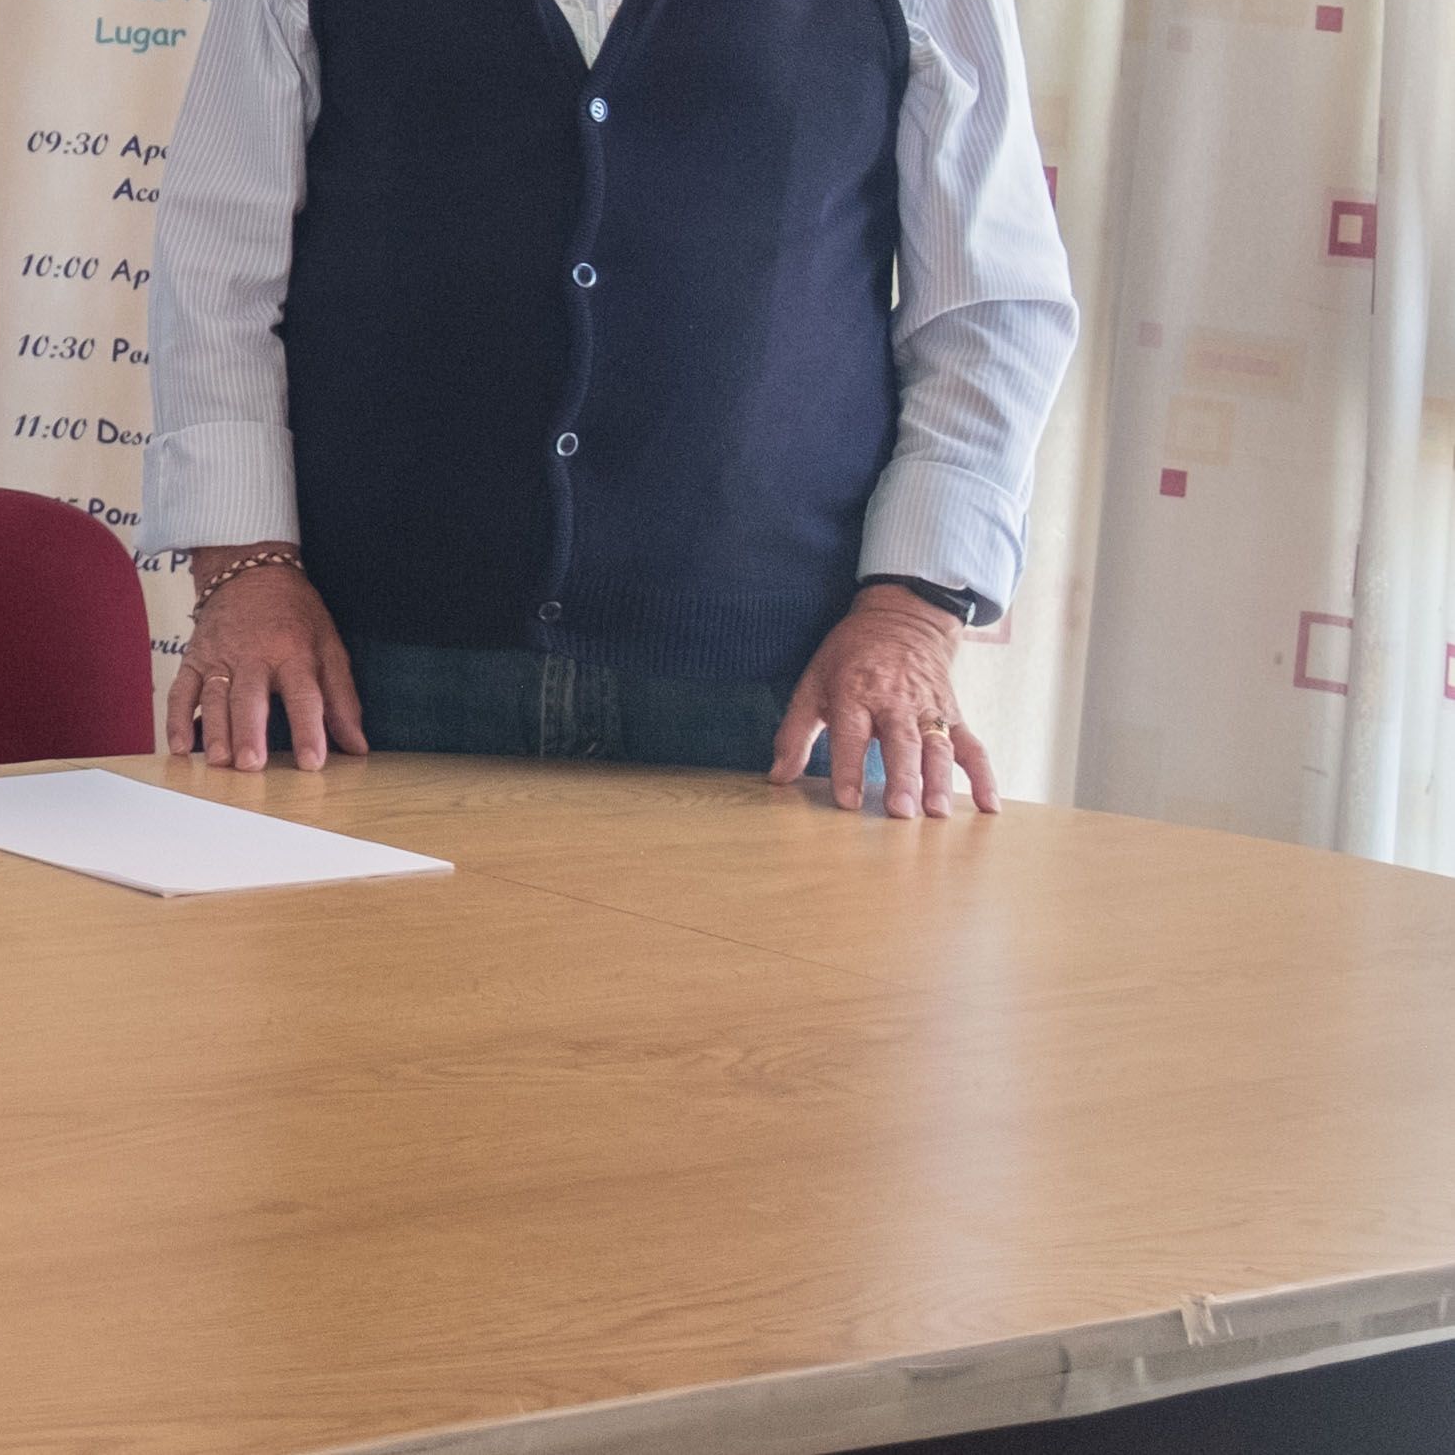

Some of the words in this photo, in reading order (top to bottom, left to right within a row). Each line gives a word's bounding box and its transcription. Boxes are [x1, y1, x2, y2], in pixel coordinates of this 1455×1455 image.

[95, 17, 187, 54] Lugar
[27, 130, 109, 155] 09:30
[21, 254, 99, 280] 10:00
[110, 259, 150, 290] Ap
[17, 334, 95, 360] 10:30
[14, 414, 88, 440] 11:00
